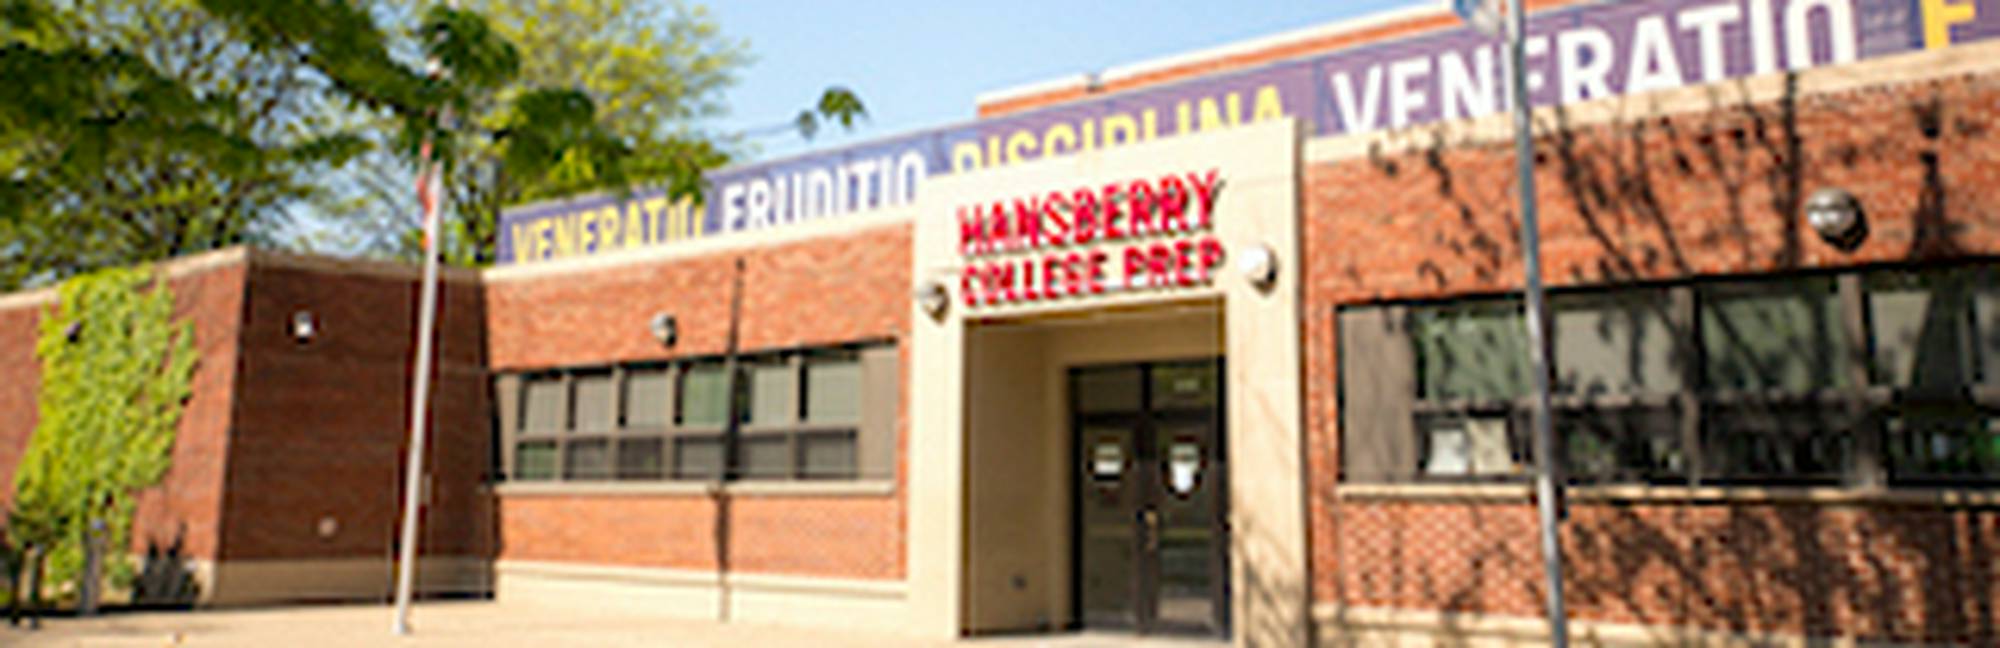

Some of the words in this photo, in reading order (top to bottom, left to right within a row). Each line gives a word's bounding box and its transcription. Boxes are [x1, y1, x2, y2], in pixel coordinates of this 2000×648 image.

[958, 169, 1219, 257] HANSBERRY
[961, 252, 1107, 306] COLLEGE
[1123, 237, 1224, 287] PREP
